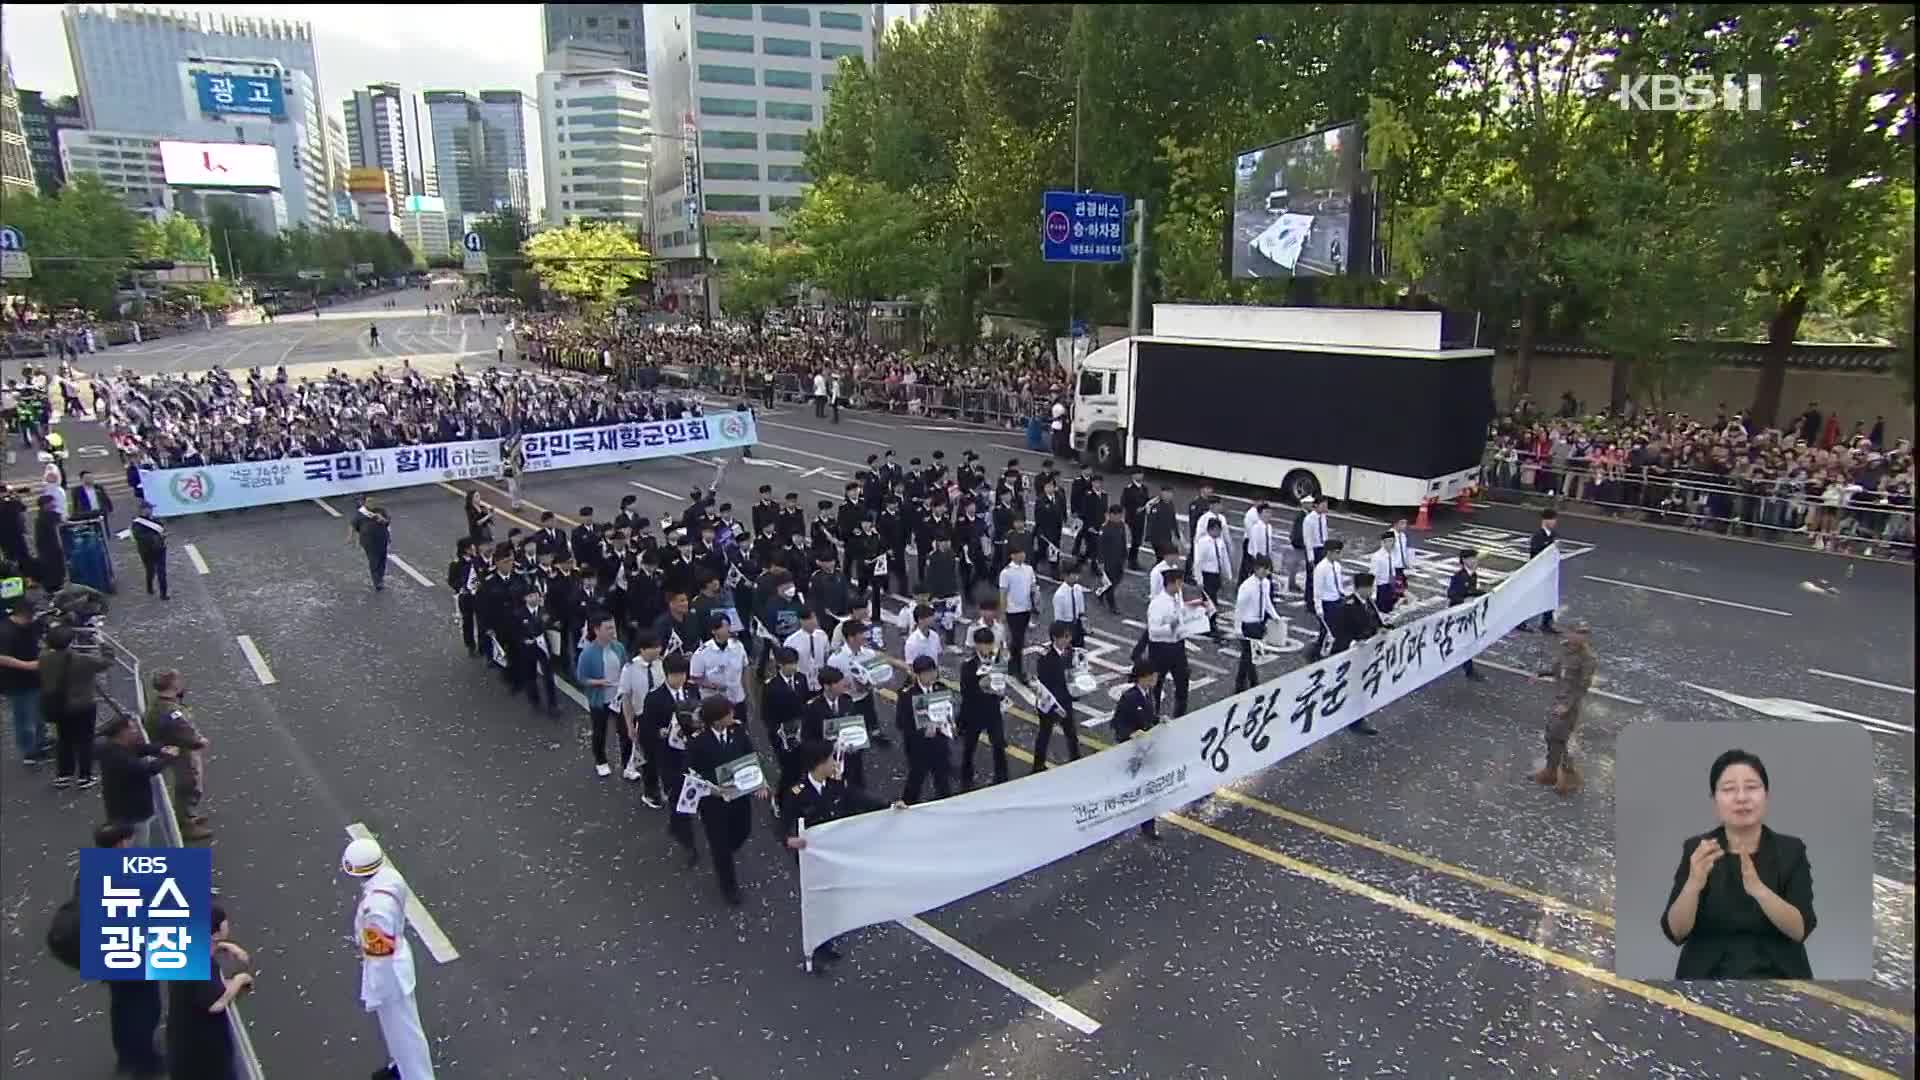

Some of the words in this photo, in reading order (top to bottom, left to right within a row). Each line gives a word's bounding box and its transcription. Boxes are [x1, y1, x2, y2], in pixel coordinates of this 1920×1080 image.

[209, 79, 273, 103] 광고
[1075, 201, 1120, 218] 관광버스
[303, 455, 385, 482] 국민과
[520, 419, 710, 461] 한민국재향군인회
[1200, 688, 1282, 773] 강한
[1290, 659, 1352, 734] 국군
[1361, 622, 1427, 699] 국민과
[1433, 597, 1489, 663] 함께!
